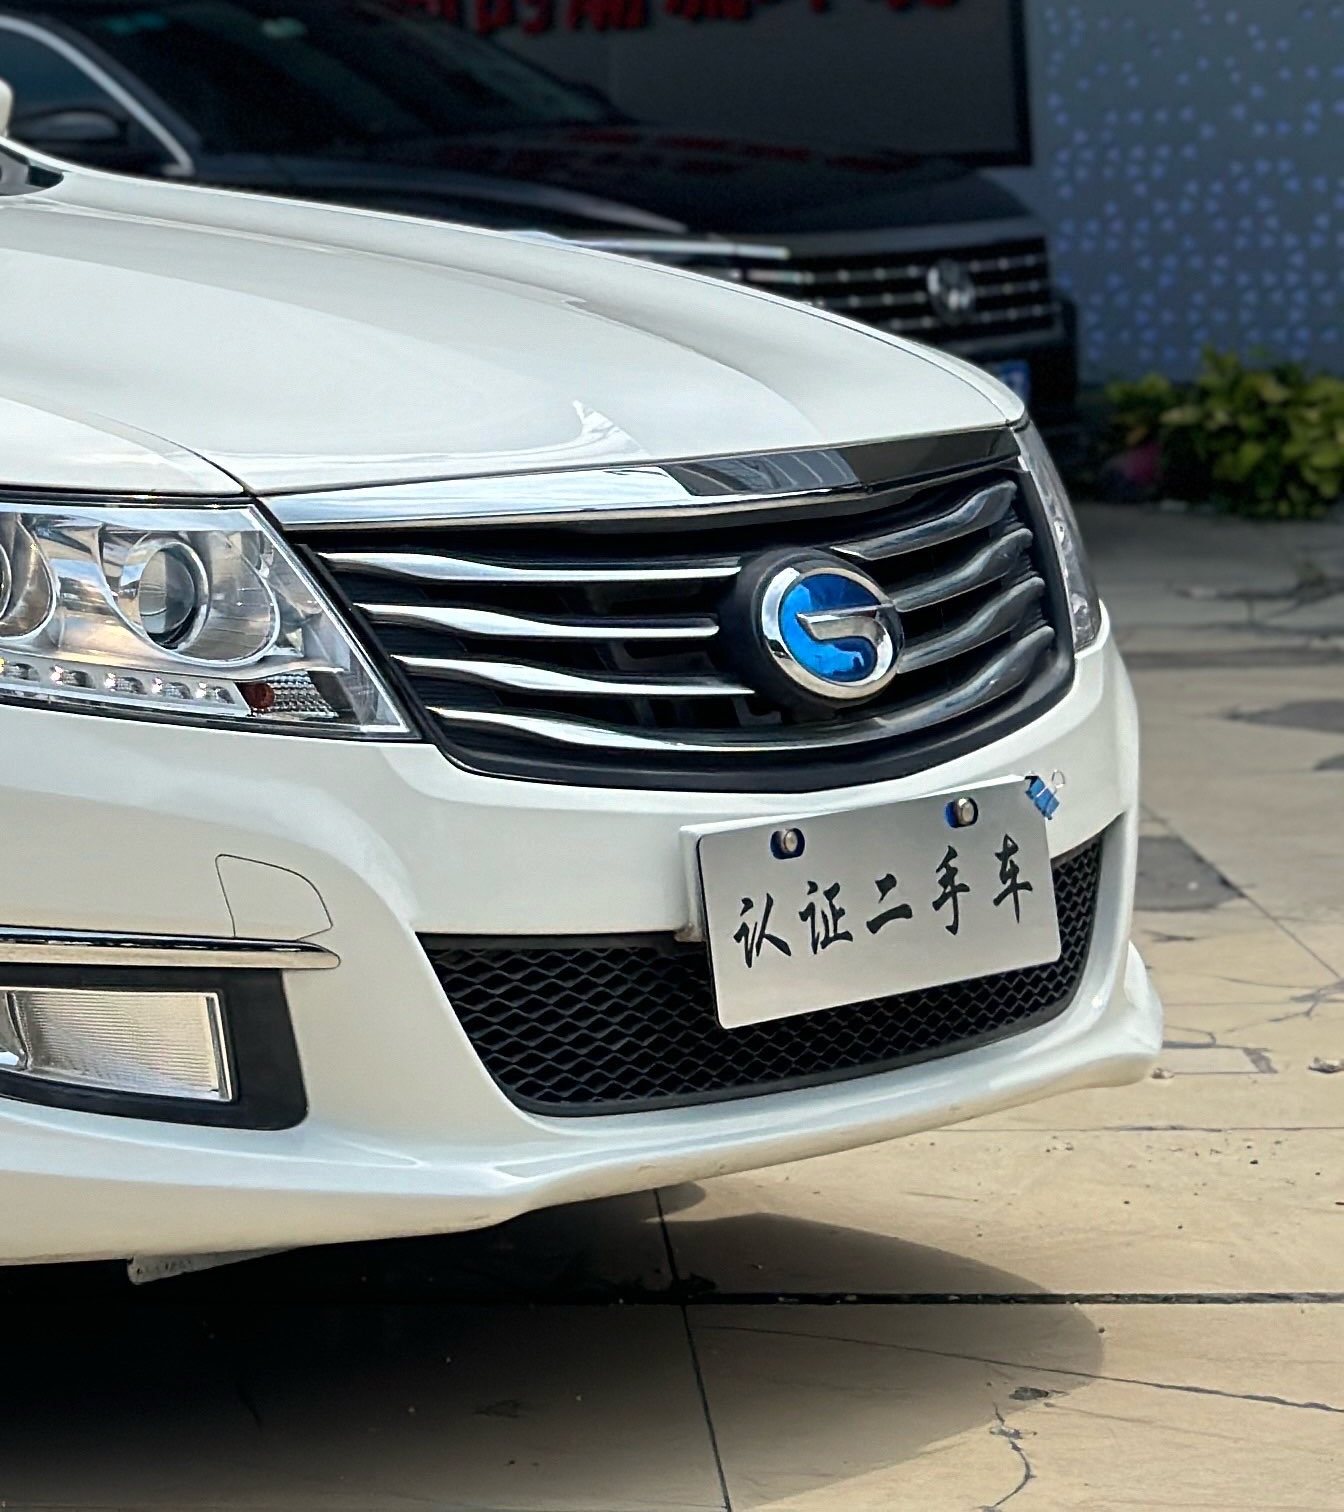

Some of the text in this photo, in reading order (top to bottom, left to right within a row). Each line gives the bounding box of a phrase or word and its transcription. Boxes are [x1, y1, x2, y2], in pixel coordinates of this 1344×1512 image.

[733, 834, 1033, 968] 认证二手车
